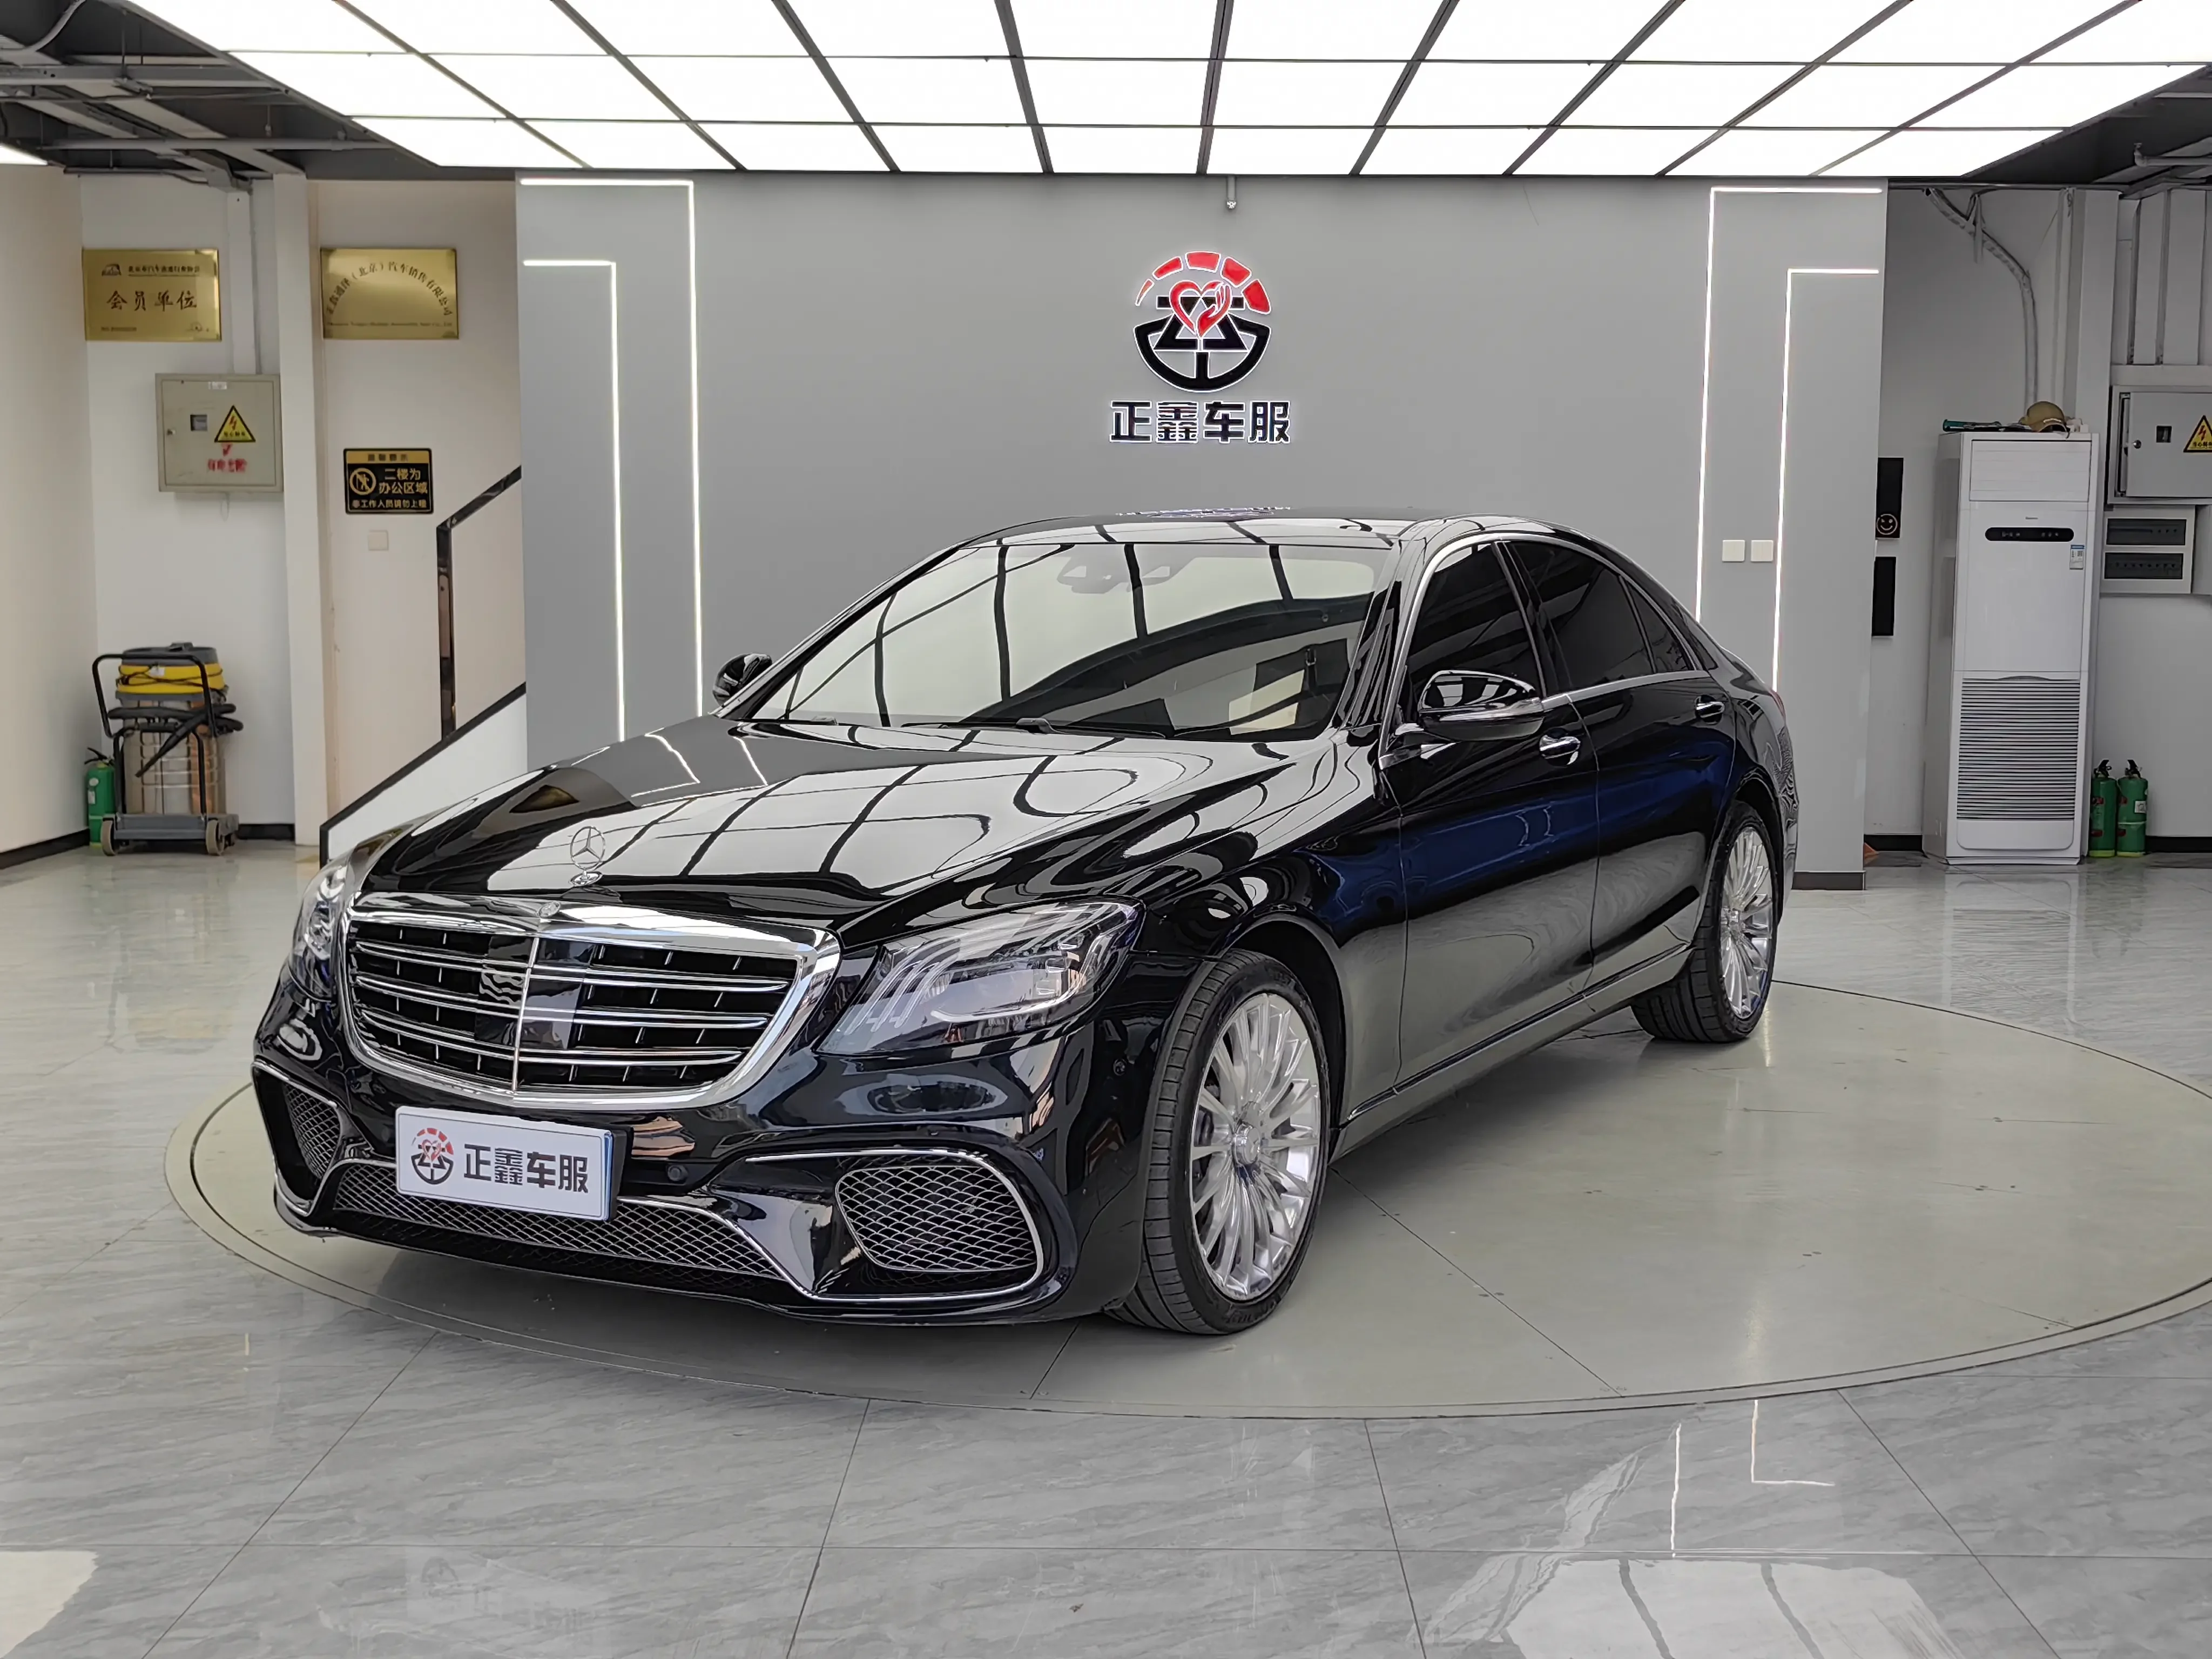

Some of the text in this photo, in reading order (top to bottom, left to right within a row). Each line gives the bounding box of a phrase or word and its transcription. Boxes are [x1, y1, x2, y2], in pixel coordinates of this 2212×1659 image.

[106, 290, 197, 312] 会员单位
[1110, 401, 1291, 444] 正鑫车服
[385, 468, 421, 480] 二楼为
[379, 482, 428, 494] 办公区域
[463, 1143, 589, 1193] 正鑫车服
